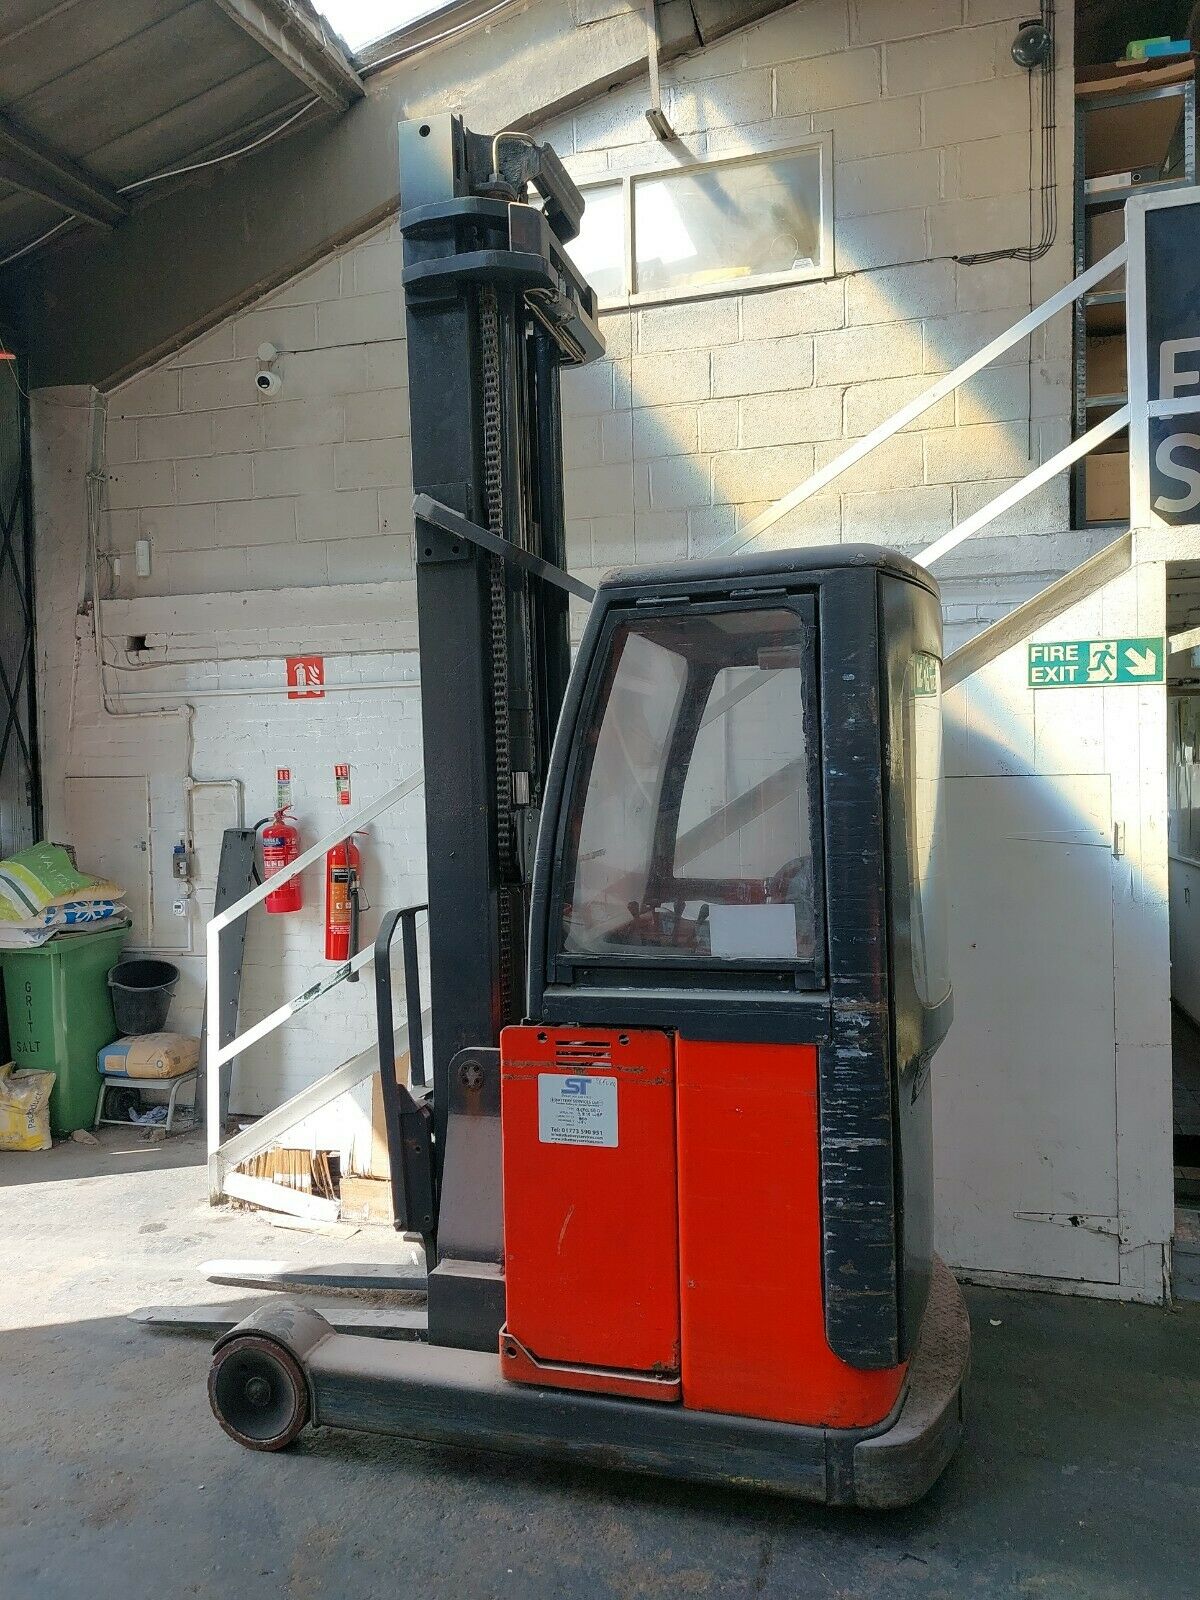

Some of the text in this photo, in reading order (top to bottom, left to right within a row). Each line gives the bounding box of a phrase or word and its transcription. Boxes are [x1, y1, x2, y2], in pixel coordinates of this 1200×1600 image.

[1031, 645, 1079, 663] FIRE
[1031, 665, 1079, 683] EXIT
[17, 1040, 41, 1053] SALT
[561, 1078, 592, 1095] ST
